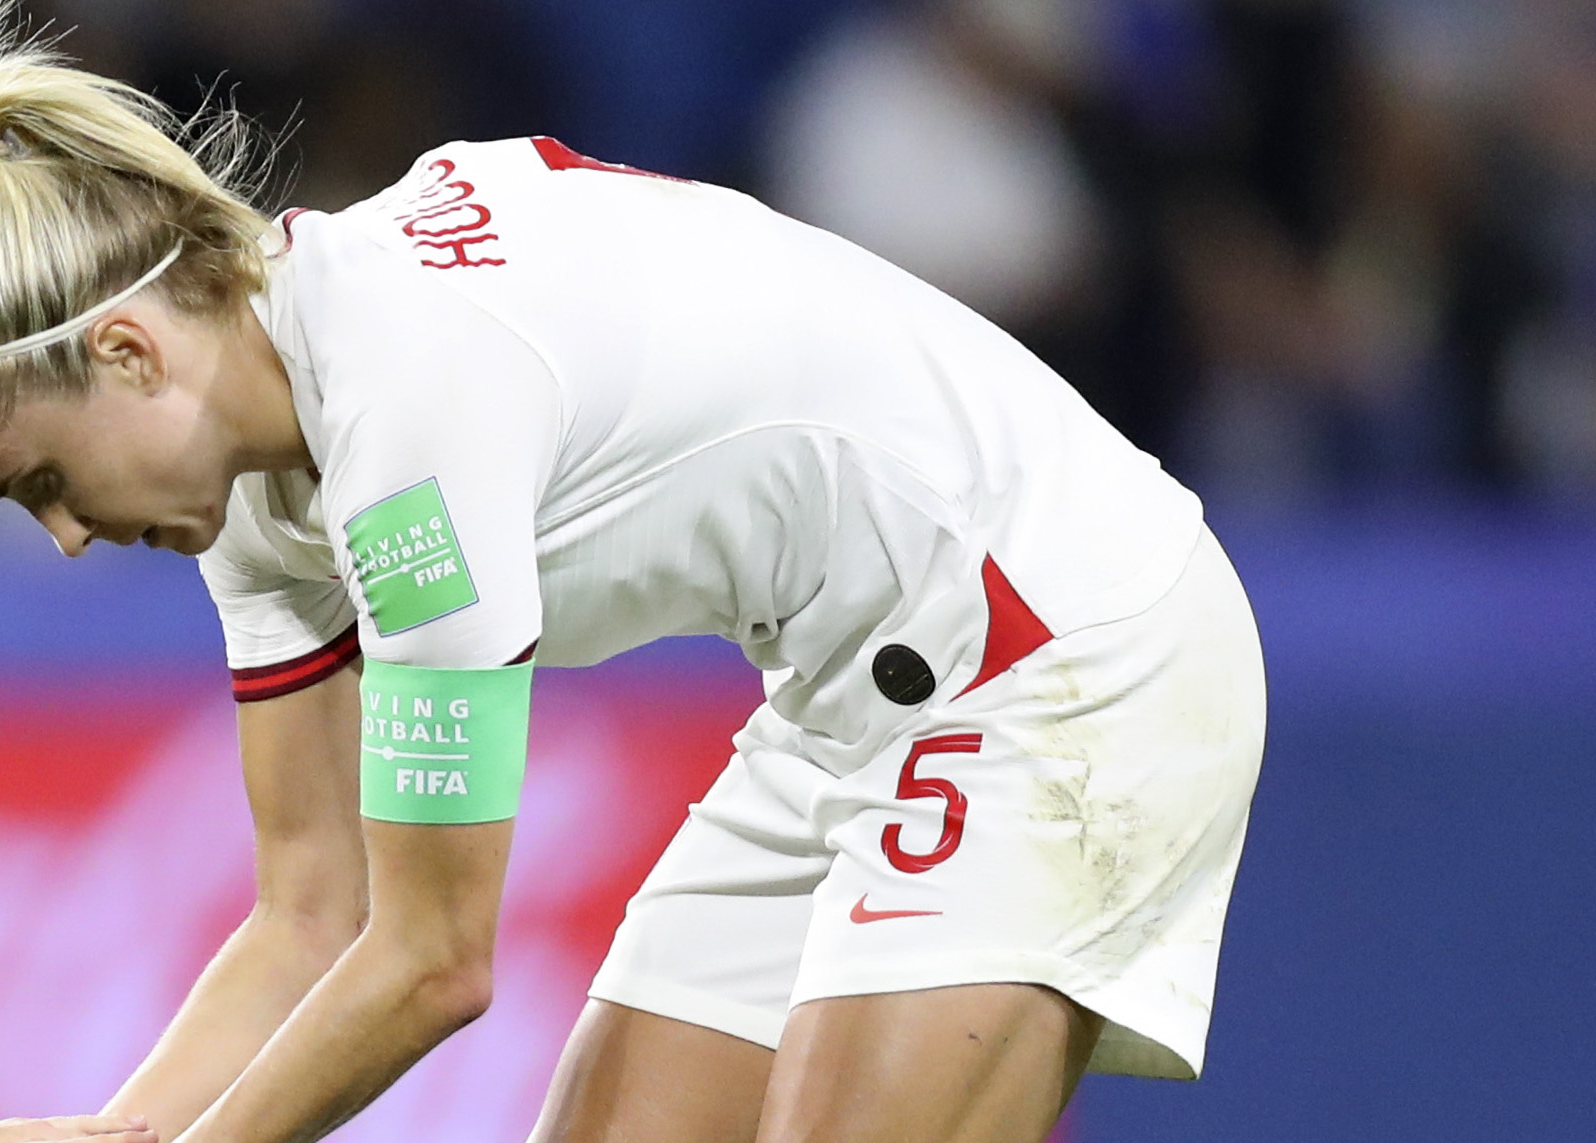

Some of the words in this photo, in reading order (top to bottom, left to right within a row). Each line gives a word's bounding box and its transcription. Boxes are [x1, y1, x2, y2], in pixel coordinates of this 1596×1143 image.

[355, 515, 442, 562] LIVING
[414, 555, 459, 587] FIFA
[367, 691, 470, 719] VING
[363, 719, 470, 744] OTBALL
[396, 767, 469, 795] FIFA
[880, 733, 984, 874] 5
